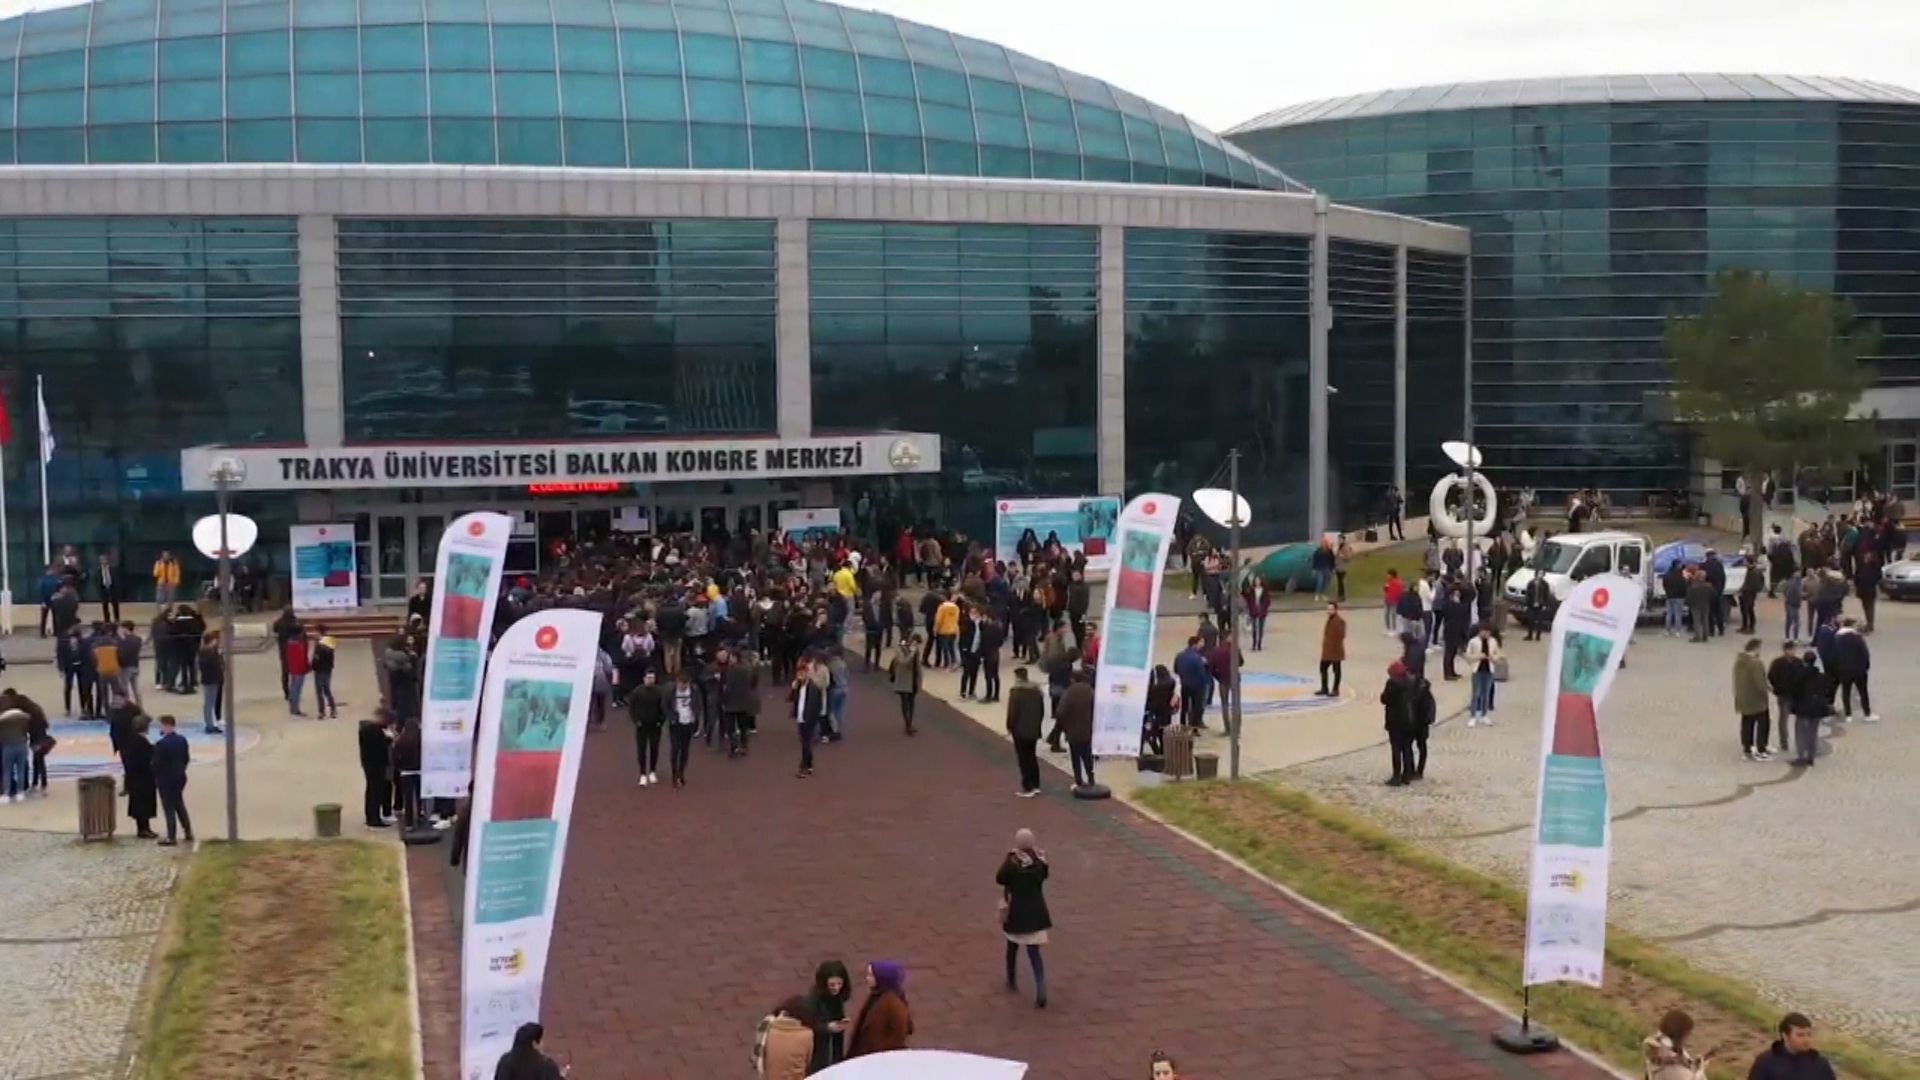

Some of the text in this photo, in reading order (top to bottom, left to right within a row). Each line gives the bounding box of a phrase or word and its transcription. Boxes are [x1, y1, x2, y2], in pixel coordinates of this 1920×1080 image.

[279, 441, 862, 480] TRAKYA ÜNİVERSİTESİ BALKAN KONGRE MERKEZİ
